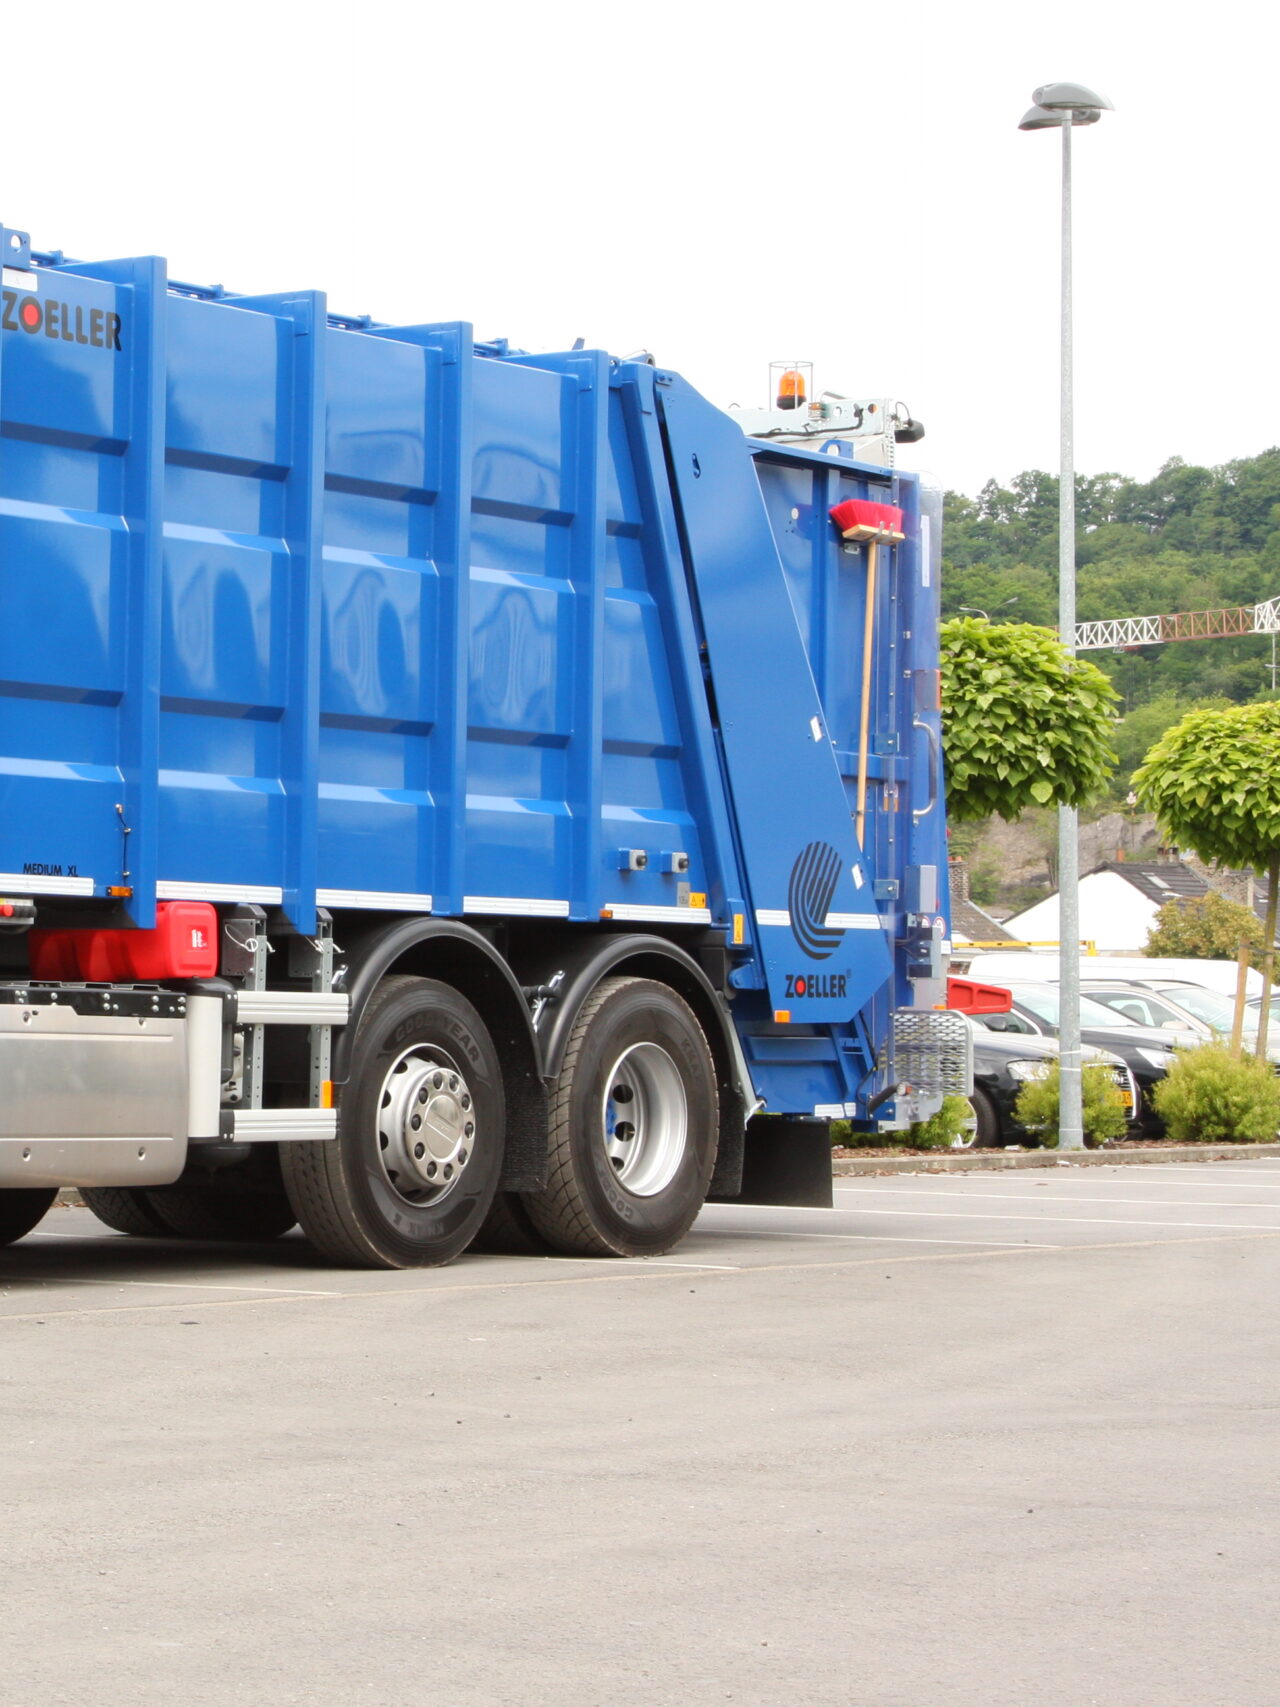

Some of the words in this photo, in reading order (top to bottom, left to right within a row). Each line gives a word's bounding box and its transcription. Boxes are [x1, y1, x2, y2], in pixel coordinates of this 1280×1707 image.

[1, 290, 122, 352] ZOELLER
[23, 862, 63, 876] MEDIUM
[67, 865, 79, 877] XL
[784, 974, 847, 998] ZOELLER
